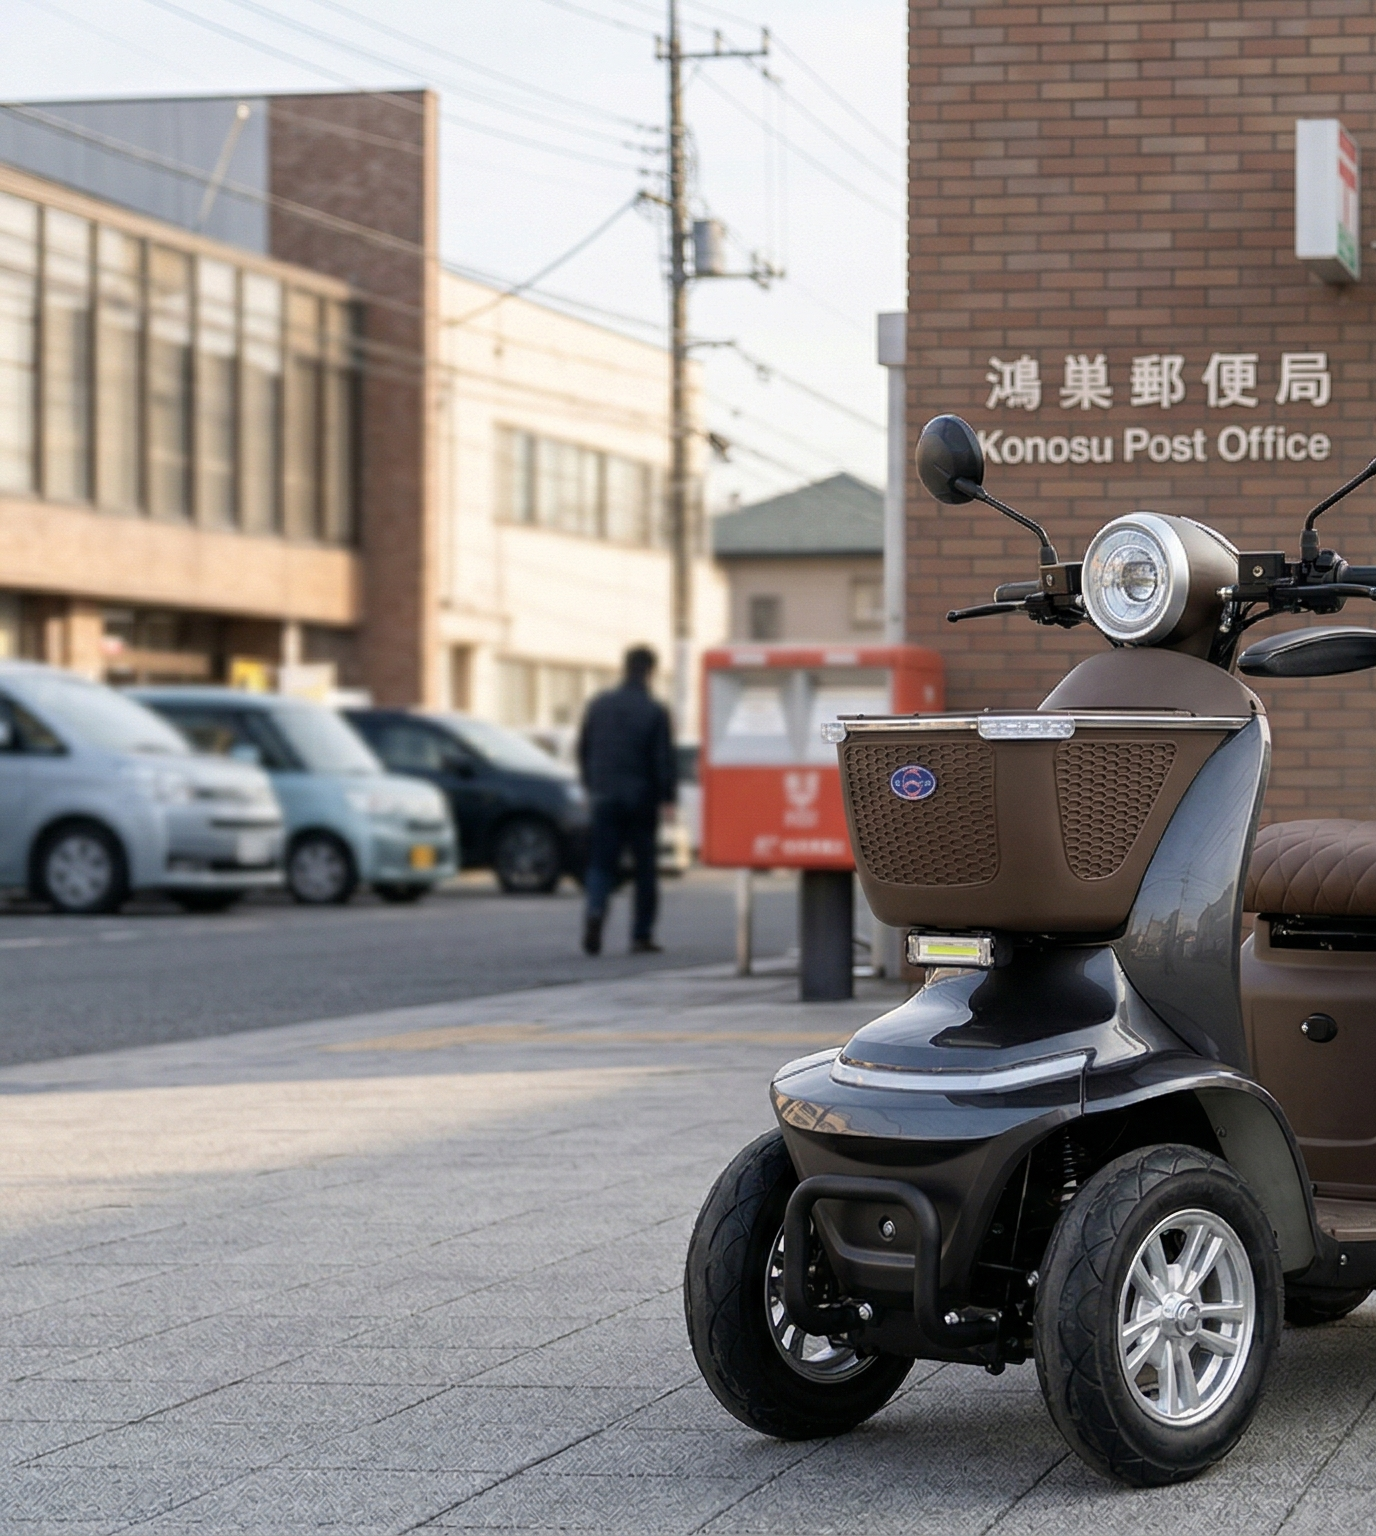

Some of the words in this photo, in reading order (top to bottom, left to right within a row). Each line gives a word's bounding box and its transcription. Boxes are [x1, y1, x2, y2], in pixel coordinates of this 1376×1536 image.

[985, 353, 1331, 410] 鴻巣郵便局
[977, 429, 1114, 464] Konosu
[1124, 428, 1206, 463] Post
[1217, 426, 1331, 461] Office
